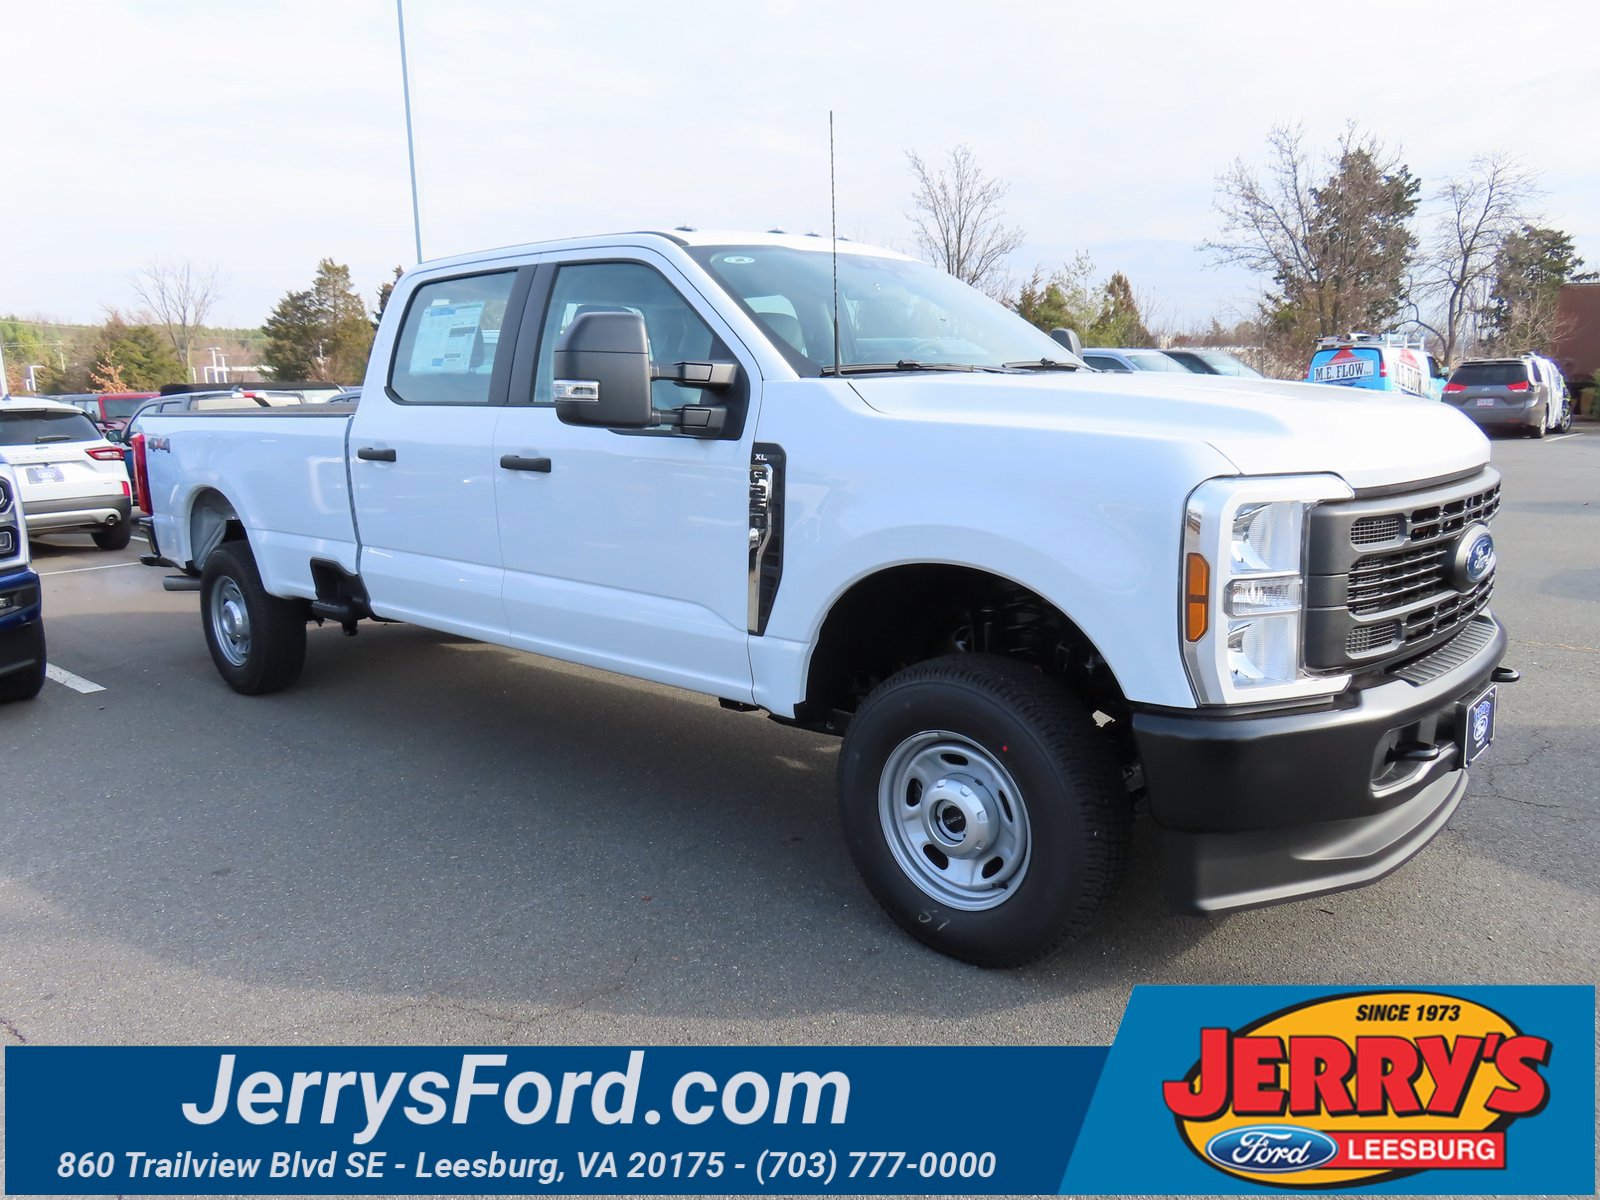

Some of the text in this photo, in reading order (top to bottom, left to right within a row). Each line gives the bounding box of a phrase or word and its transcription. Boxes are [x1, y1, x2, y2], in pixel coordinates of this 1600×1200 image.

[1315, 367, 1335, 381] M.E.
[1336, 362, 1364, 378] FLOW
[755, 453, 767, 461] XL
